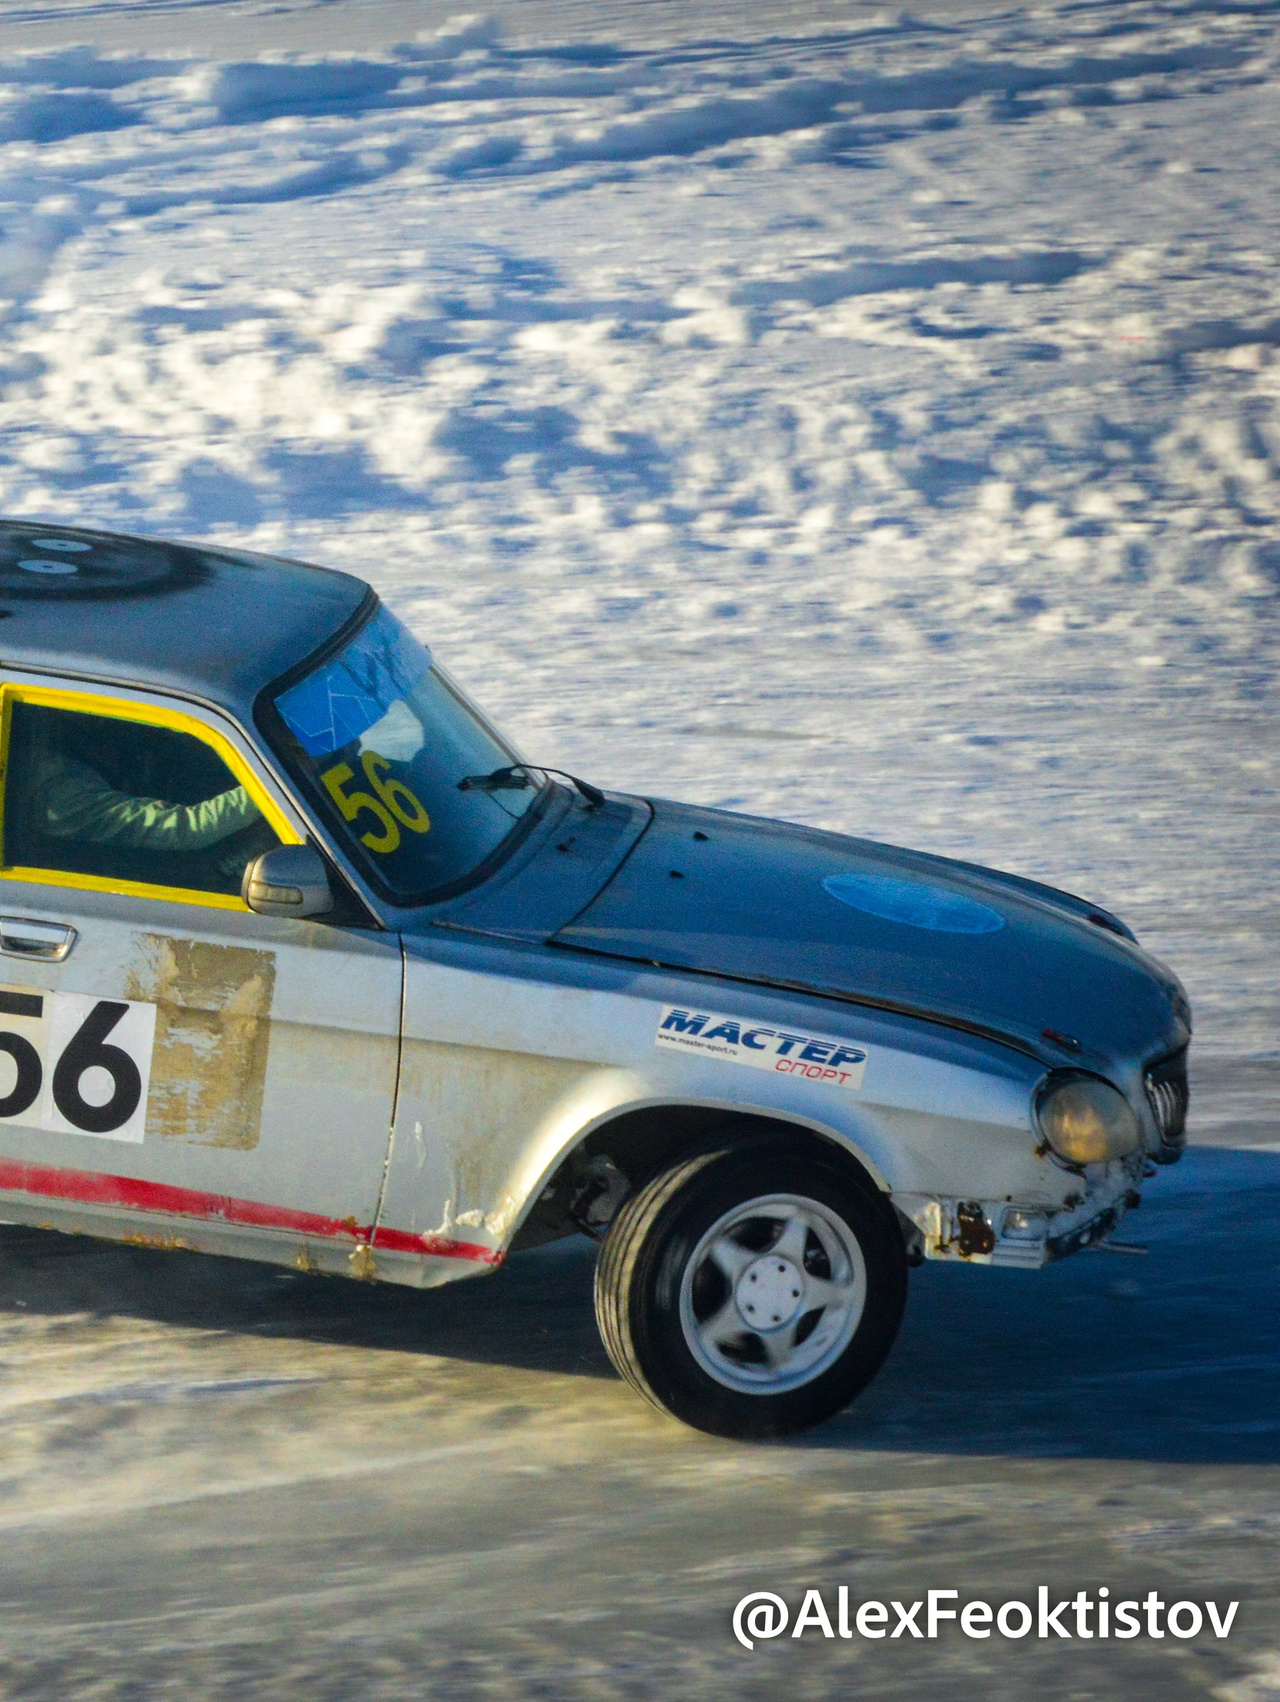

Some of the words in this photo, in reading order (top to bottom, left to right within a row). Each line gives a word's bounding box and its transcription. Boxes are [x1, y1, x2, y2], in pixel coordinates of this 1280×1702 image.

[321, 750, 431, 853] 56
[658, 1034, 738, 1056] www.master-sport.ru
[661, 1009, 867, 1067] МАСТЕР
[775, 1058, 852, 1085] СПОРТ
